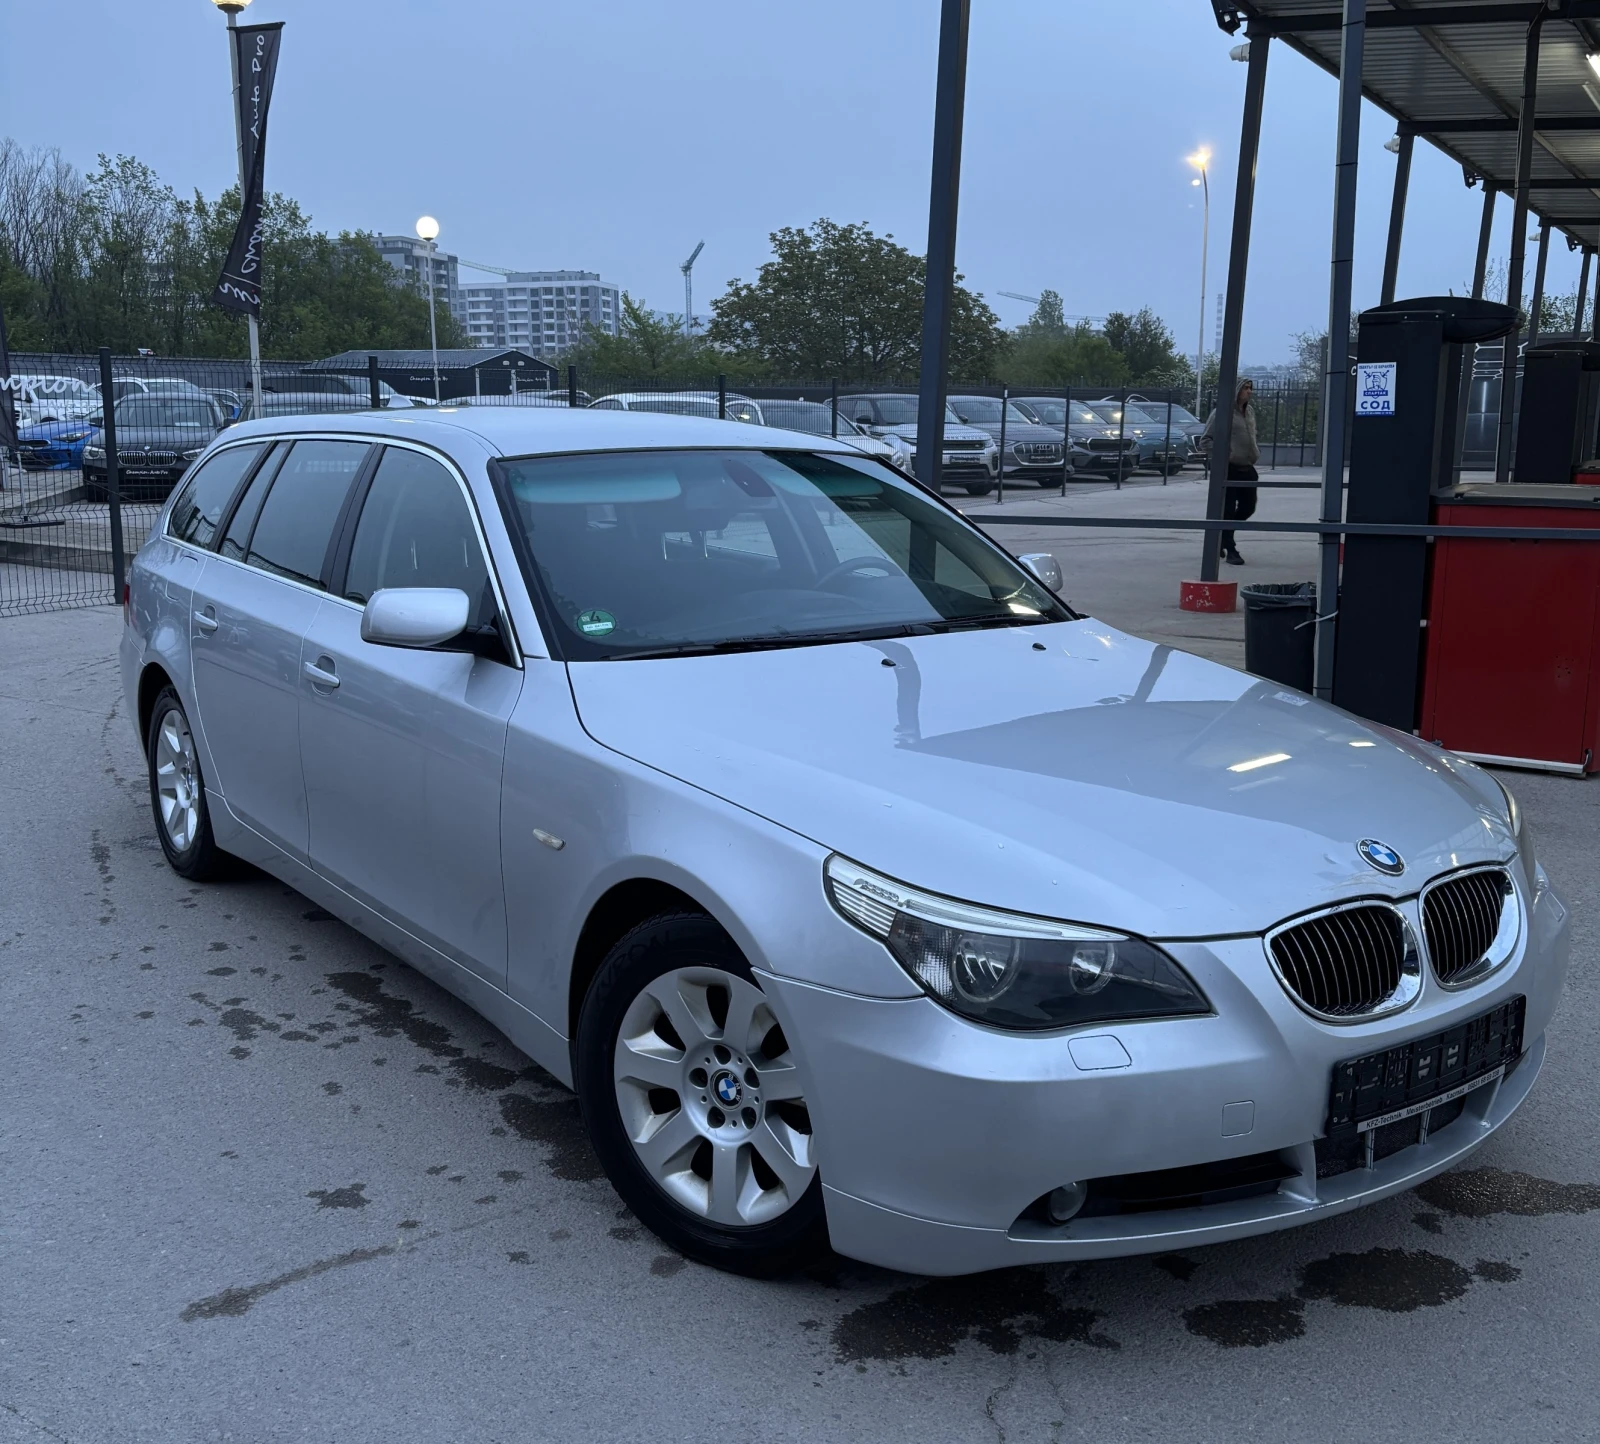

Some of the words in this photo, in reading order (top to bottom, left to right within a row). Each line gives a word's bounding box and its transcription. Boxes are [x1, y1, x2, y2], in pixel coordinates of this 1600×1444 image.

[251, 34, 265, 73] Pro
[250, 85, 260, 139] Auto
[1360, 400, 1390, 410] СОД
[590, 611, 601, 623] 4
[1366, 1112, 1402, 1128] KFZ-Technik
[1405, 1098, 1443, 1116] Meisterbetrieb
